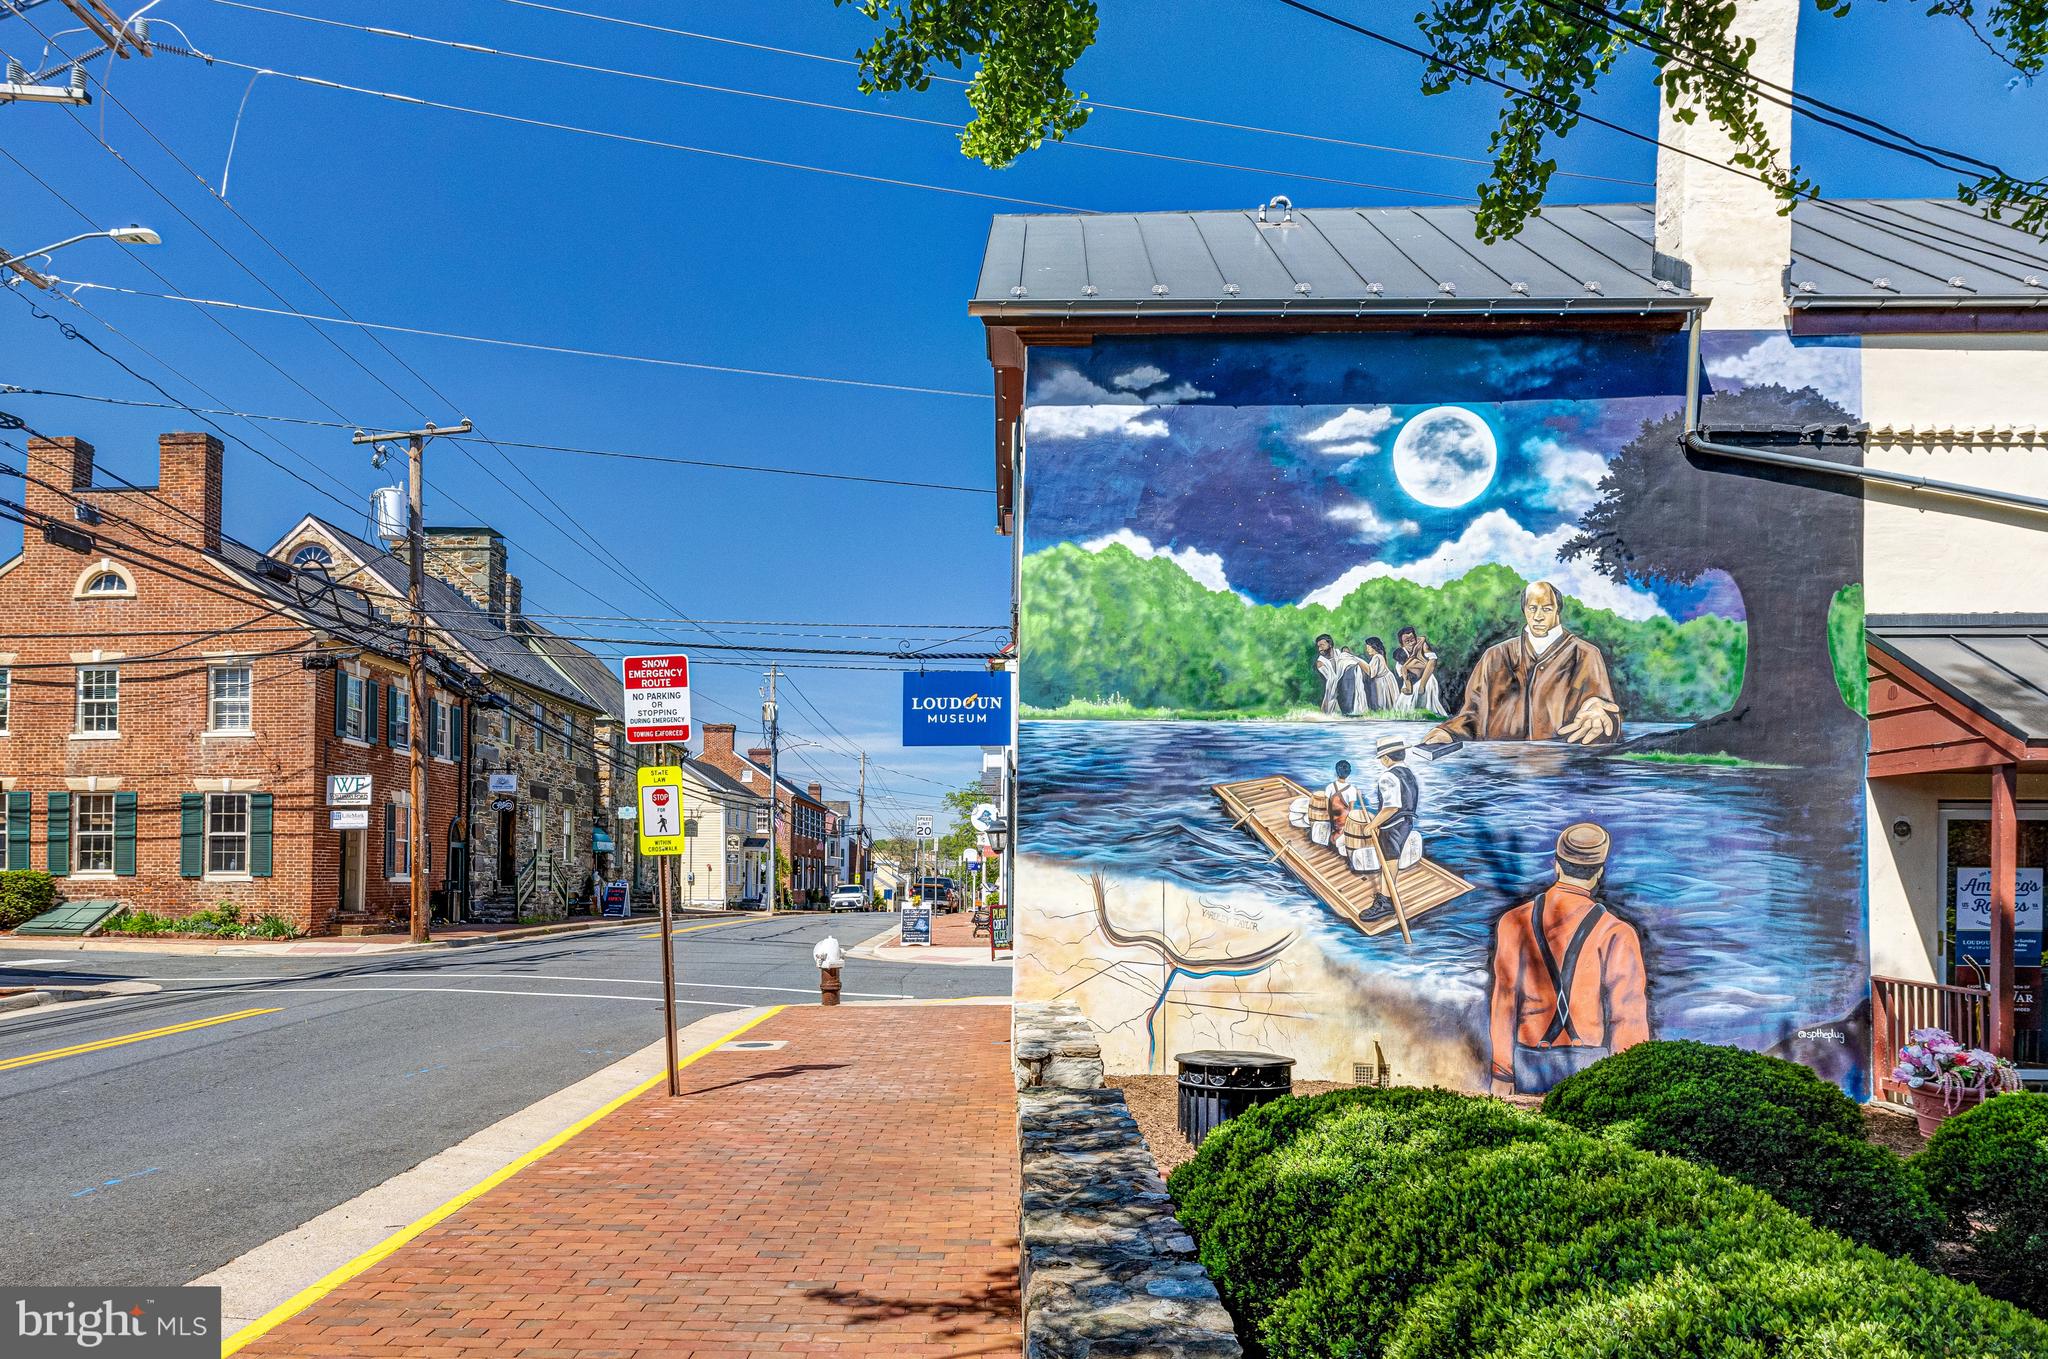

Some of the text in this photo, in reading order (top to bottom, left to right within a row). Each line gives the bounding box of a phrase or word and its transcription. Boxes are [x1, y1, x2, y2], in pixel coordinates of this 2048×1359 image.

[642, 659, 669, 668] SNOW
[628, 669, 683, 678] EMERGENCY
[641, 678, 671, 687] ROUTE
[646, 691, 681, 700] PARKING
[911, 696, 1002, 710] LOUDOUN
[637, 708, 678, 717] STOPPING
[630, 716, 685, 725] DURING EMERGENCY
[927, 714, 987, 723] MUSEUM
[633, 729, 684, 738] TOWING ENFORCED
[652, 793, 669, 801] STOP
[916, 826, 932, 836] 20
[1960, 877, 2041, 897] Amca's
[1971, 898, 2030, 915] Roes
[1797, 1028, 1845, 1044] @sptheplug
